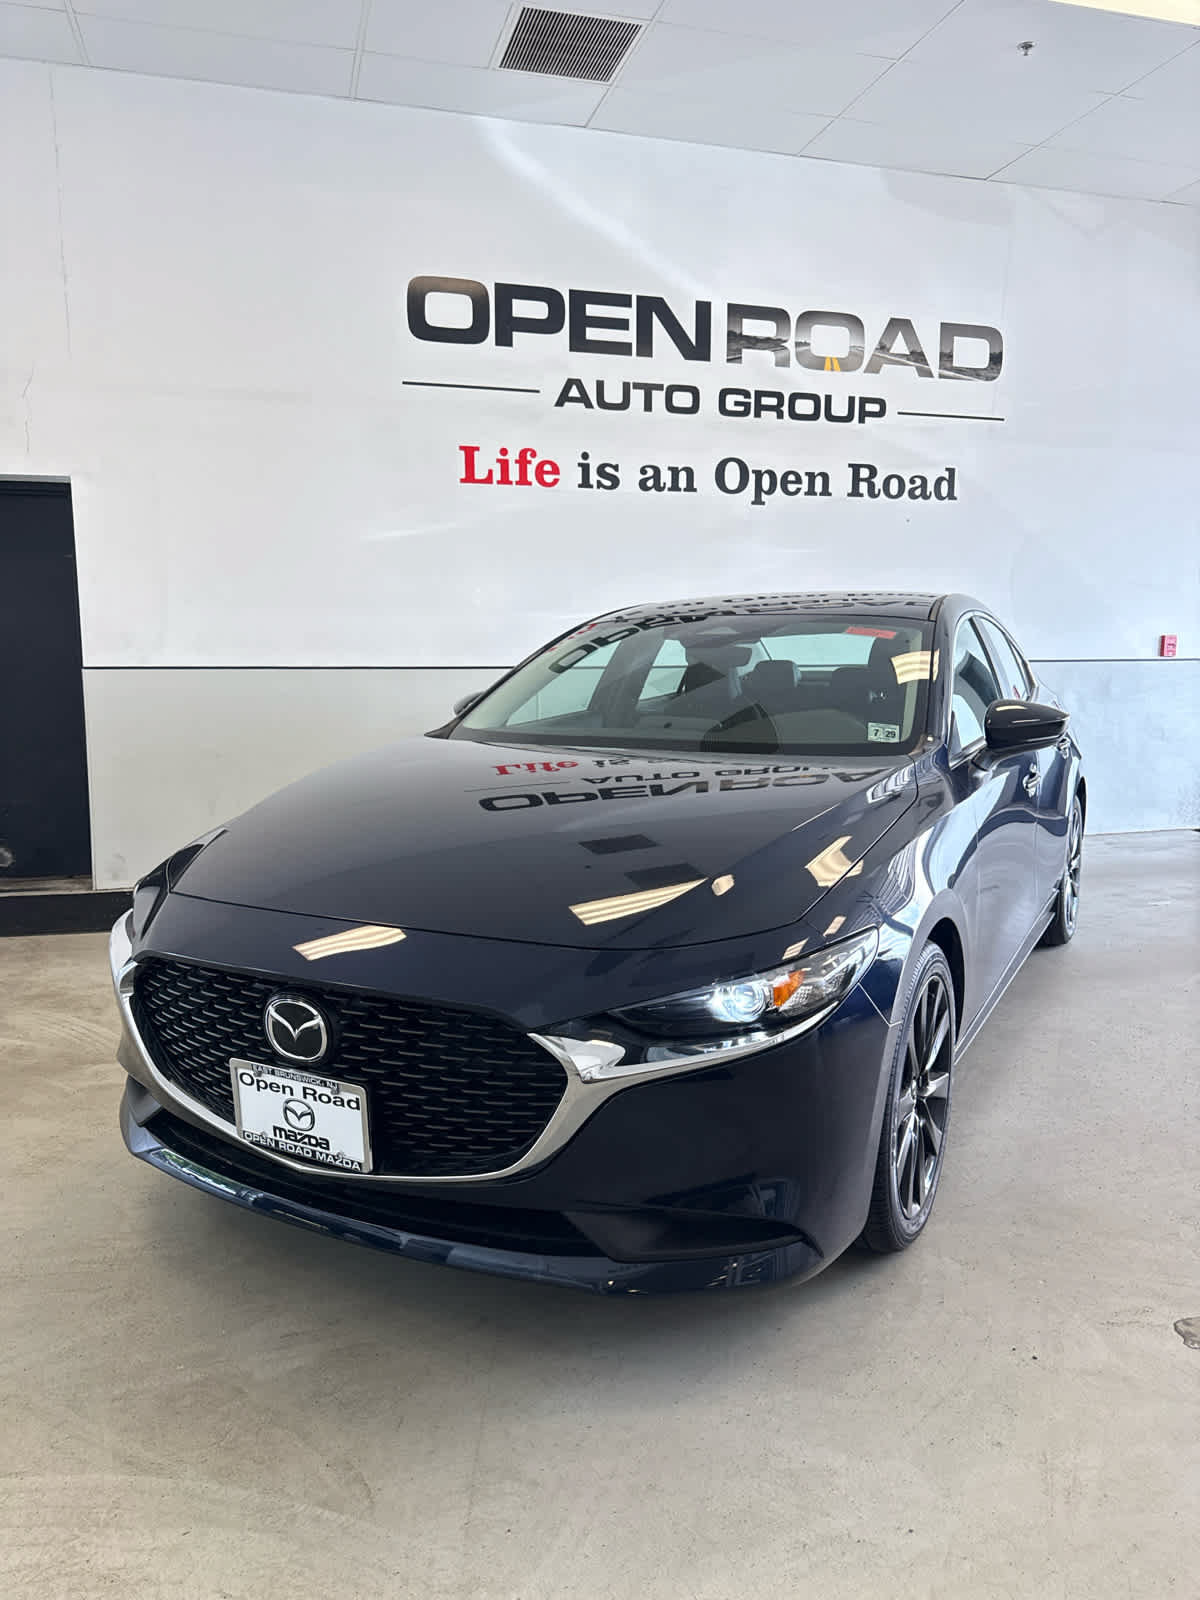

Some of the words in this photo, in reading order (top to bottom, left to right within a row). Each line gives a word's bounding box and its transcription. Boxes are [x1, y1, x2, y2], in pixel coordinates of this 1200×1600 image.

[406, 275, 711, 362] OPEN
[726, 303, 1004, 382] ROAD
[554, 378, 700, 415] AUTO
[718, 388, 887, 424] GROUP
[459, 446, 561, 488] Life
[577, 452, 620, 490] is
[638, 460, 698, 493] an
[714, 457, 833, 505] Open
[847, 464, 958, 501] Road
[239, 1072, 294, 1096] Open
[302, 1086, 361, 1111] Road
[244, 1131, 275, 1148] OPEN
[278, 1140, 312, 1158] ROAD
[316, 1151, 361, 1171] MAZDA
[272, 1125, 330, 1151] mazda
